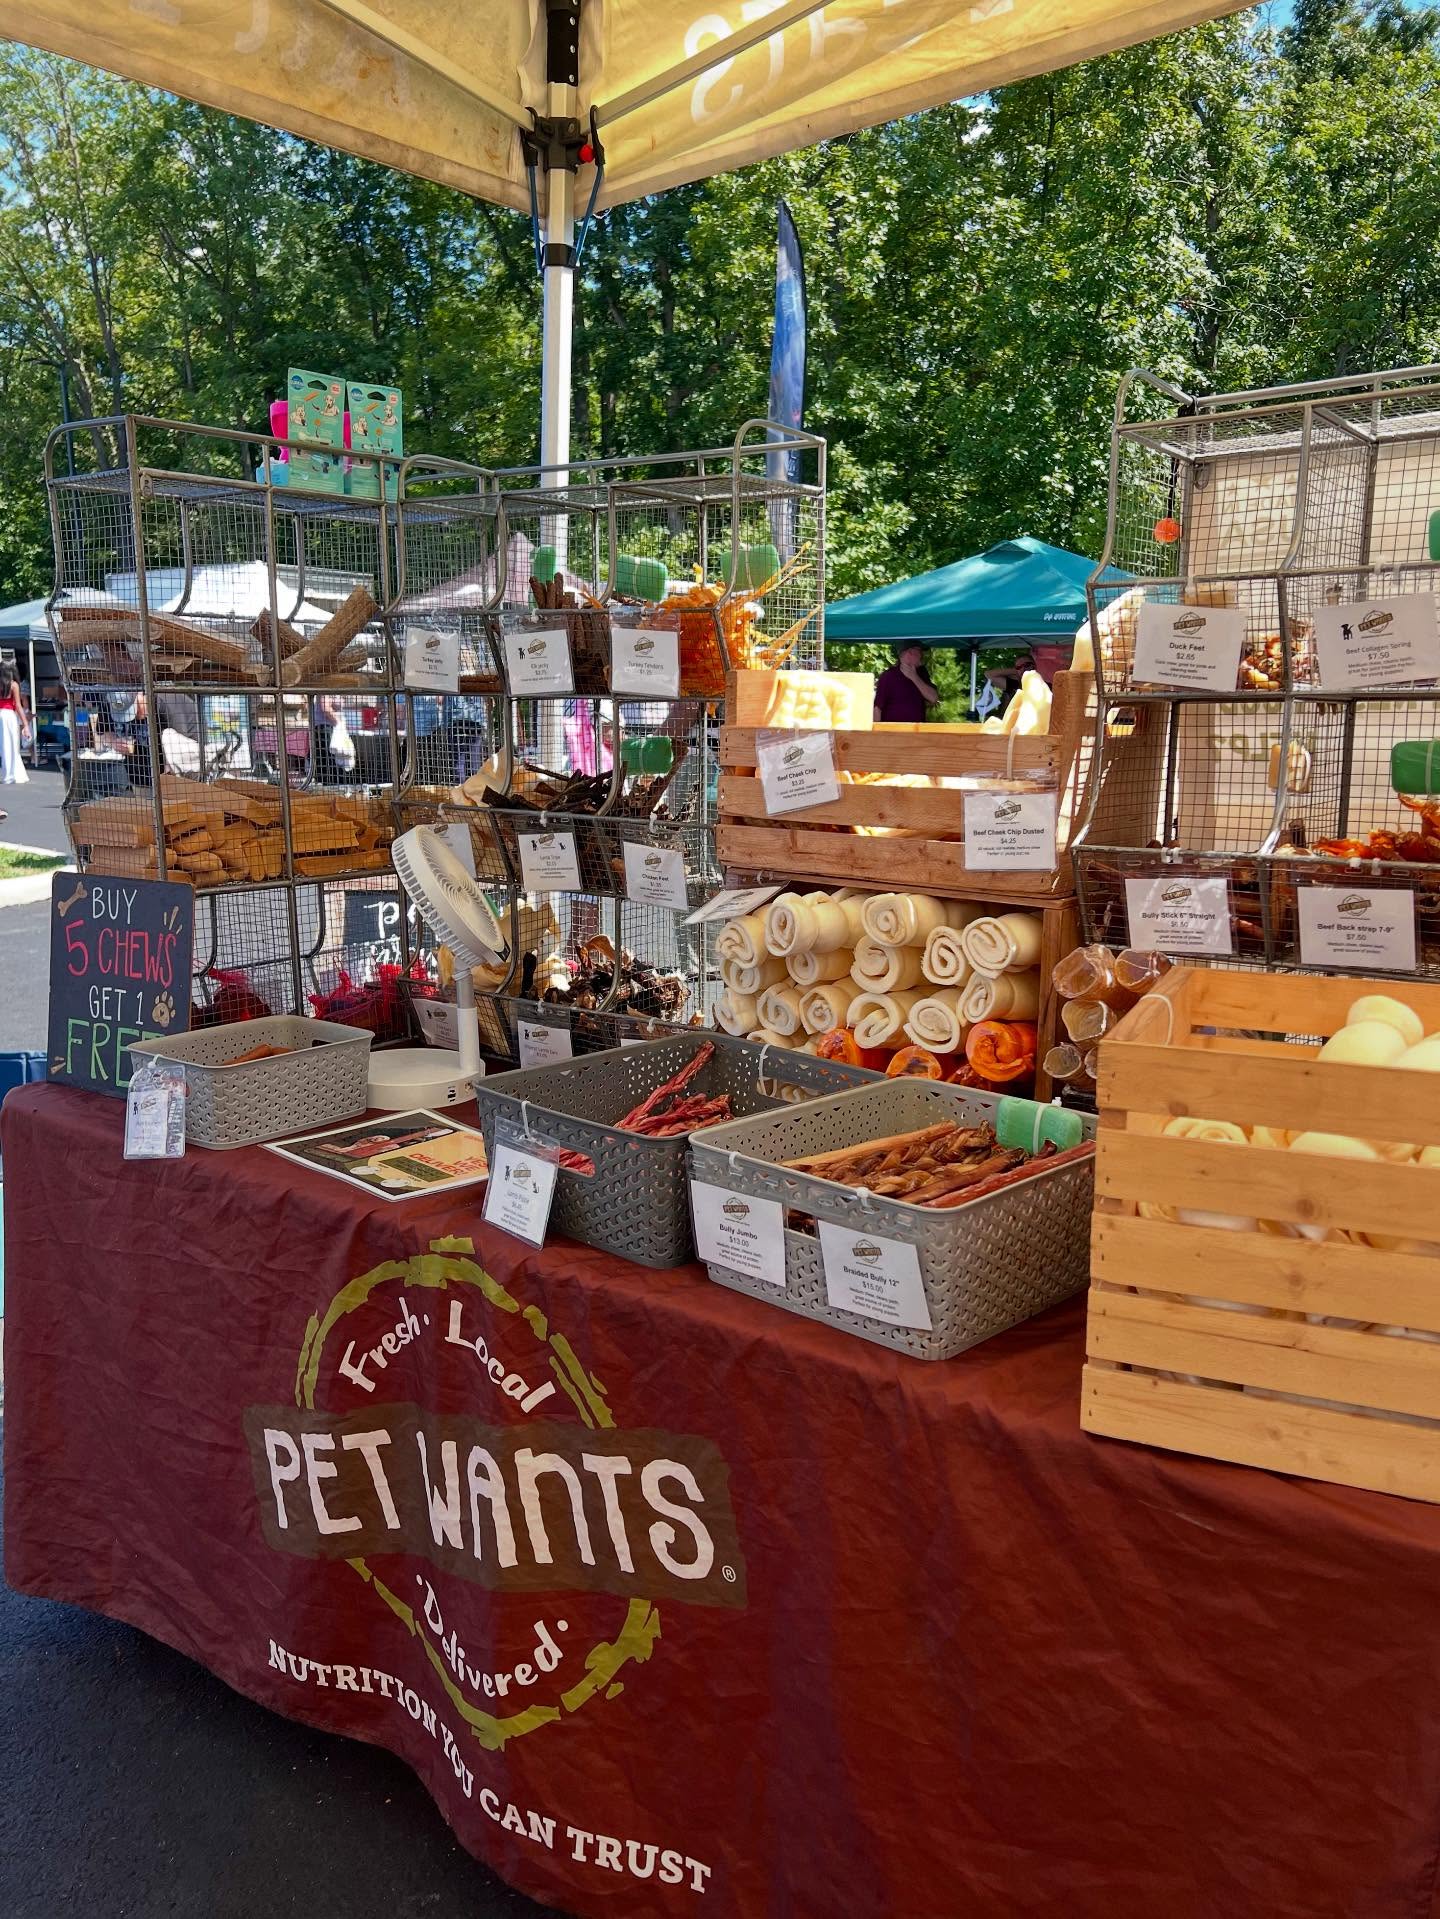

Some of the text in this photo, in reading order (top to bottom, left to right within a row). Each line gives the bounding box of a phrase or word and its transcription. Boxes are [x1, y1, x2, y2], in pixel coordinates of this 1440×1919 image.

[1169, 642, 1187, 650] Duck
[804, 768, 817, 776] Chip
[1007, 828, 1022, 836] Chip
[92, 886, 138, 924] BUY
[1188, 912, 1217, 920] Straight
[65, 919, 177, 988] 5 CHEWS
[89, 985, 145, 1026] GET 1
[719, 1223, 758, 1239] Bully Jumbo
[729, 1236, 750, 1247] $13.00
[843, 1265, 869, 1279] Braided
[870, 1273, 888, 1285] Bully
[444, 1300, 558, 1413] Local
[262, 1427, 716, 1581] PET WANTS
[266, 1638, 714, 1896] NUTRITION YOU CAN TRUST
